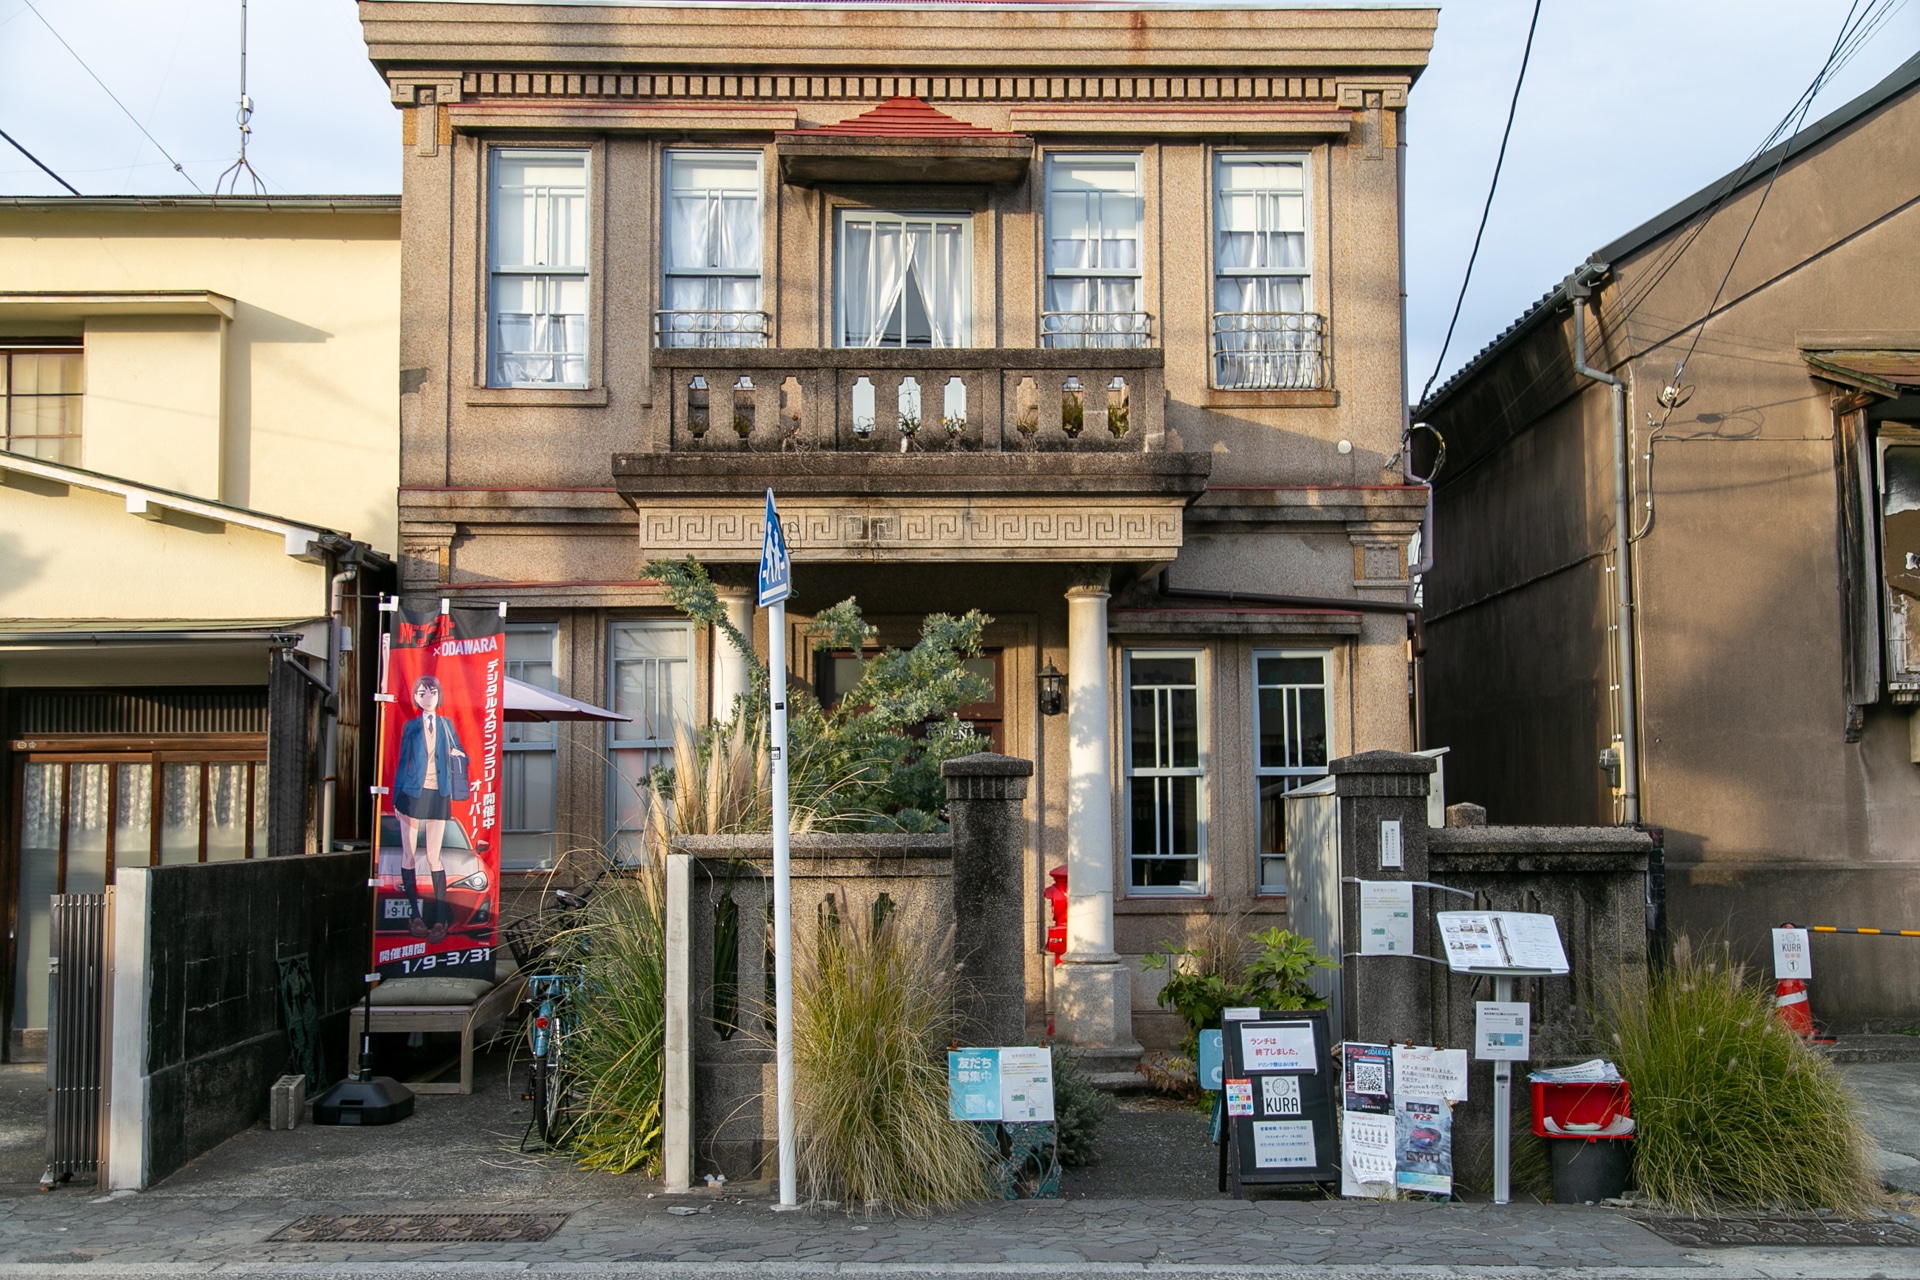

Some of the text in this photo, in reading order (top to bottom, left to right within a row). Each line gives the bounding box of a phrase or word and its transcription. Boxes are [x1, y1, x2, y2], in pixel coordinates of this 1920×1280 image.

[379, 942, 426, 963] 開催期間
[1782, 943, 1802, 952] KURA
[1250, 1037, 1277, 1045] ランチは
[1255, 1048, 1298, 1056] 終了しました。
[957, 1056, 992, 1069] 友だち
[957, 1070, 992, 1083] 募集中
[1265, 1096, 1299, 1112] KURA
